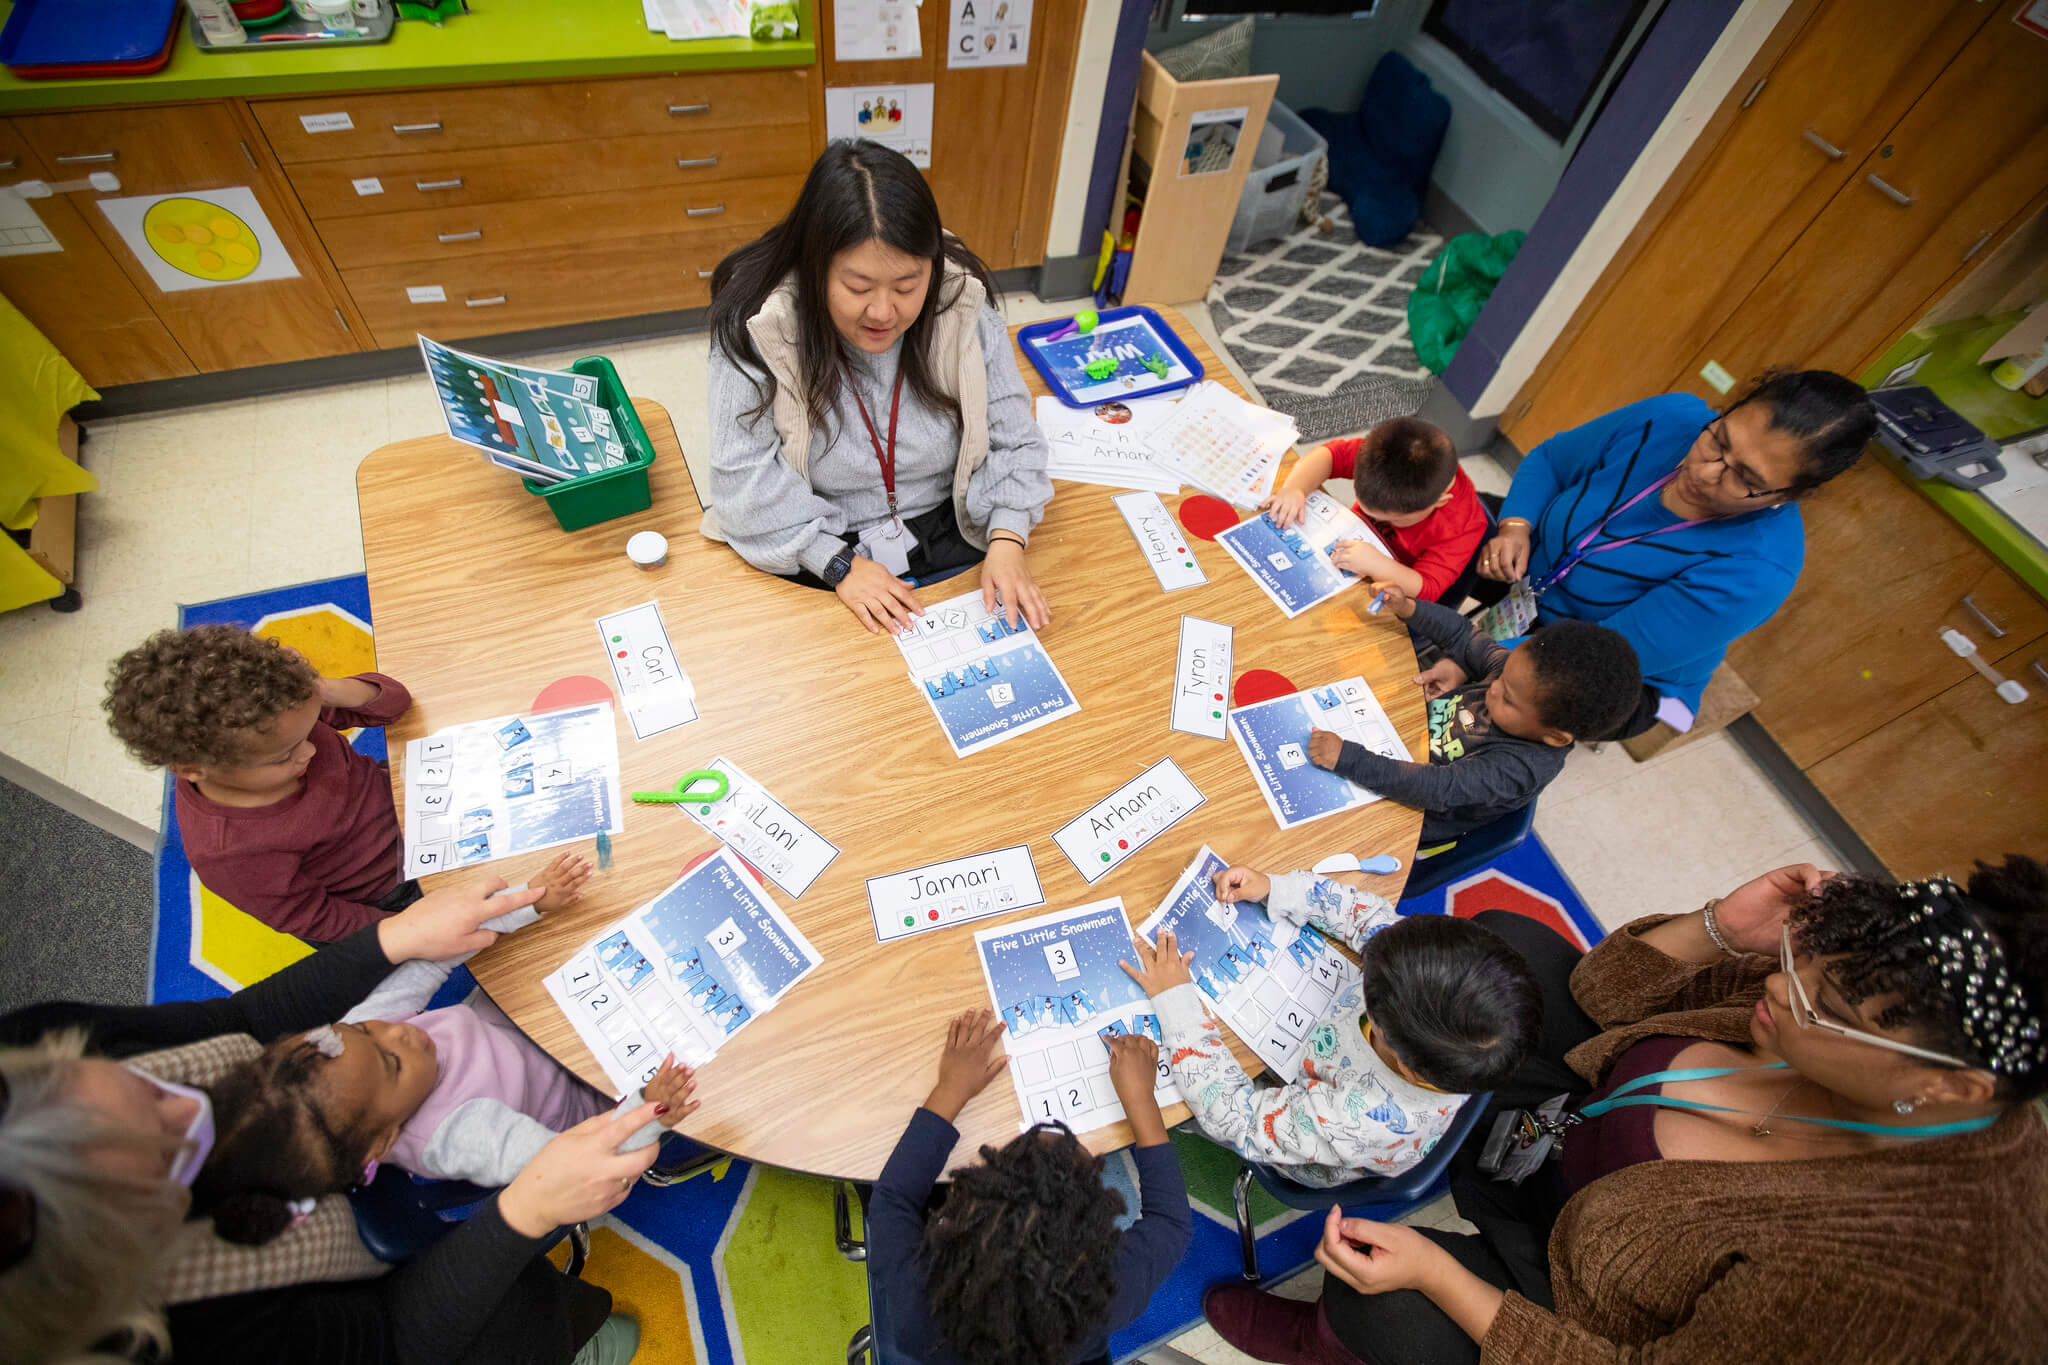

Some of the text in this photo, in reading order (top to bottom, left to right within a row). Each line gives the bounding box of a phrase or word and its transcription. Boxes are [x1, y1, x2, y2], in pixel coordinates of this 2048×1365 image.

[962, 1, 975, 19] A
[960, 35, 974, 53] C
[1137, 517, 1172, 563] Henry
[1261, 570, 1281, 591] Little
[1281, 589, 1297, 607] Five
[927, 620, 935, 629] 4
[642, 646, 673, 684] Carl
[1183, 648, 1209, 696] Tyron
[1346, 687, 1357, 696] 5
[1041, 697, 1064, 710] Five
[1011, 706, 1041, 722] Little
[1354, 708, 1366, 716] 4
[429, 744, 444, 752] 1
[1288, 750, 1299, 758] 3
[1264, 763, 1283, 792] Little
[425, 796, 442, 804] 3
[1279, 794, 1297, 816] Five
[1090, 786, 1161, 839] Arham
[420, 854, 437, 864] 5
[909, 860, 1000, 900] Jamari
[712, 865, 735, 889] Five
[733, 887, 760, 918] Little
[1158, 916, 1178, 932] ive
[719, 931, 734, 945] 3
[992, 939, 1019, 955] Five
[1022, 929, 1057, 946] Little
[1054, 950, 1066, 965] 3
[1331, 959, 1343, 970] 5
[573, 972, 590, 982] 1
[1320, 967, 1332, 980] 4
[592, 994, 608, 1011] 2
[1288, 1012, 1304, 1028] 2
[627, 1044, 641, 1057] 4
[1272, 1038, 1286, 1050] 1
[642, 1067, 658, 1083] 5
[1157, 1060, 1170, 1078] 5
[1068, 1089, 1082, 1107] 2
[1042, 1100, 1051, 1117] 1
